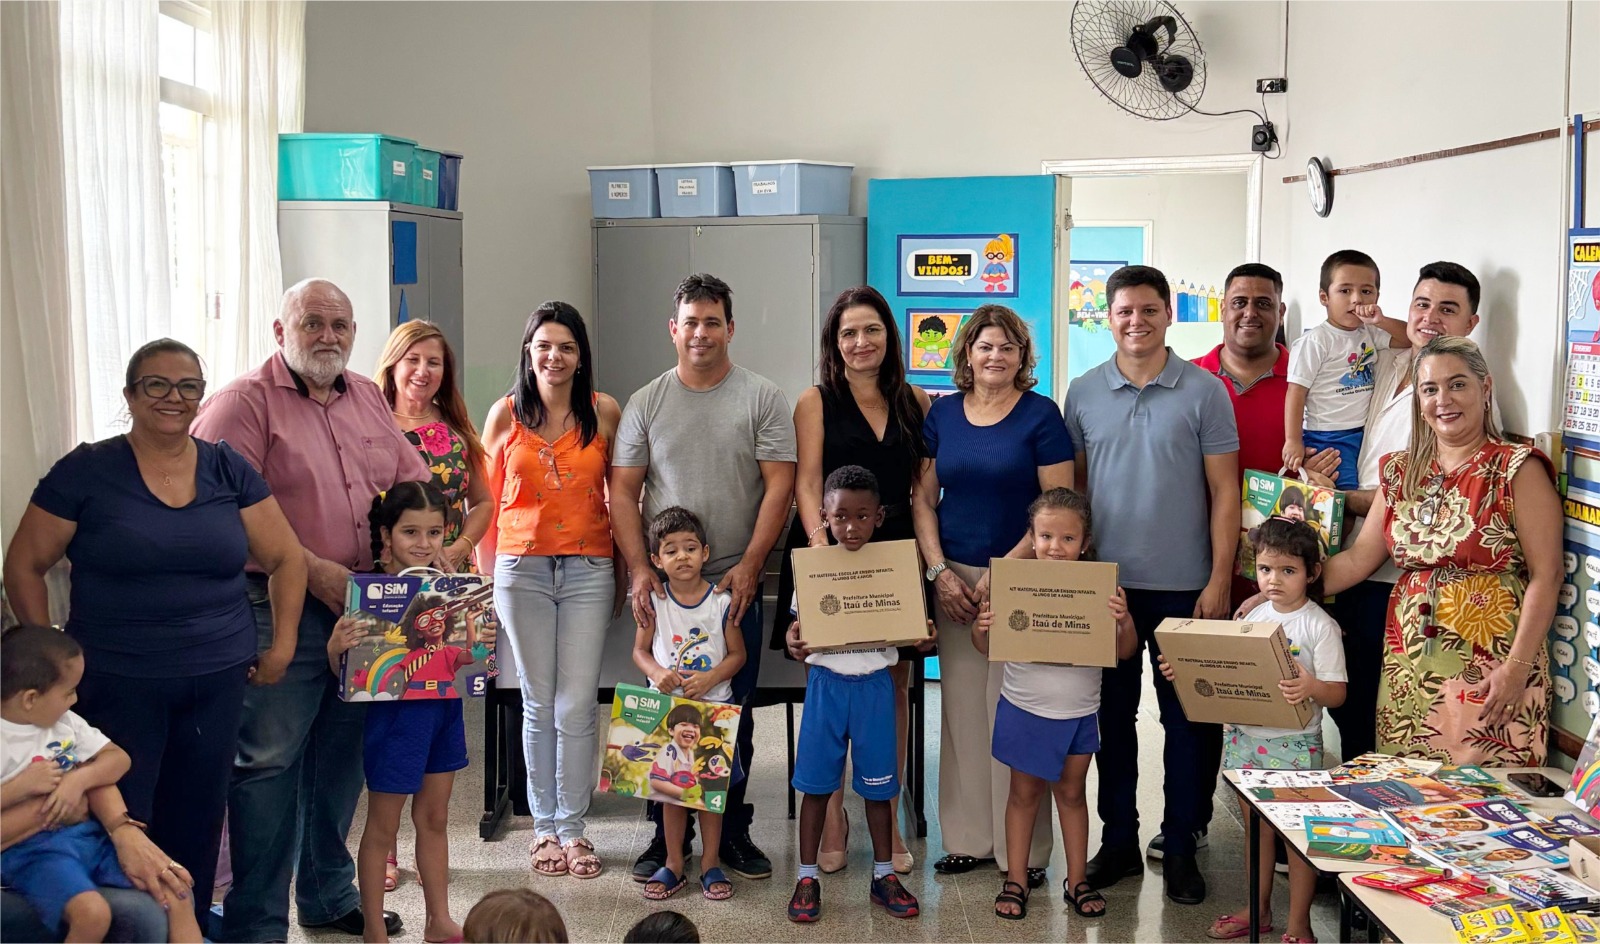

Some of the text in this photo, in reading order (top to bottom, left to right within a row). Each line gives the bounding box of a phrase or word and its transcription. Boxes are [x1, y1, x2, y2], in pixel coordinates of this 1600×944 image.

[928, 255, 958, 265] BEM-
[918, 266, 968, 276] VINDOS!
[384, 583, 408, 595] SiM
[844, 601, 860, 609] Itaú
[876, 598, 900, 607] Minas
[1065, 621, 1090, 629] Minas
[473, 677, 485, 691] 5
[1246, 690, 1271, 698] Minas
[639, 698, 660, 710] SiM
[711, 795, 722, 808] 4
